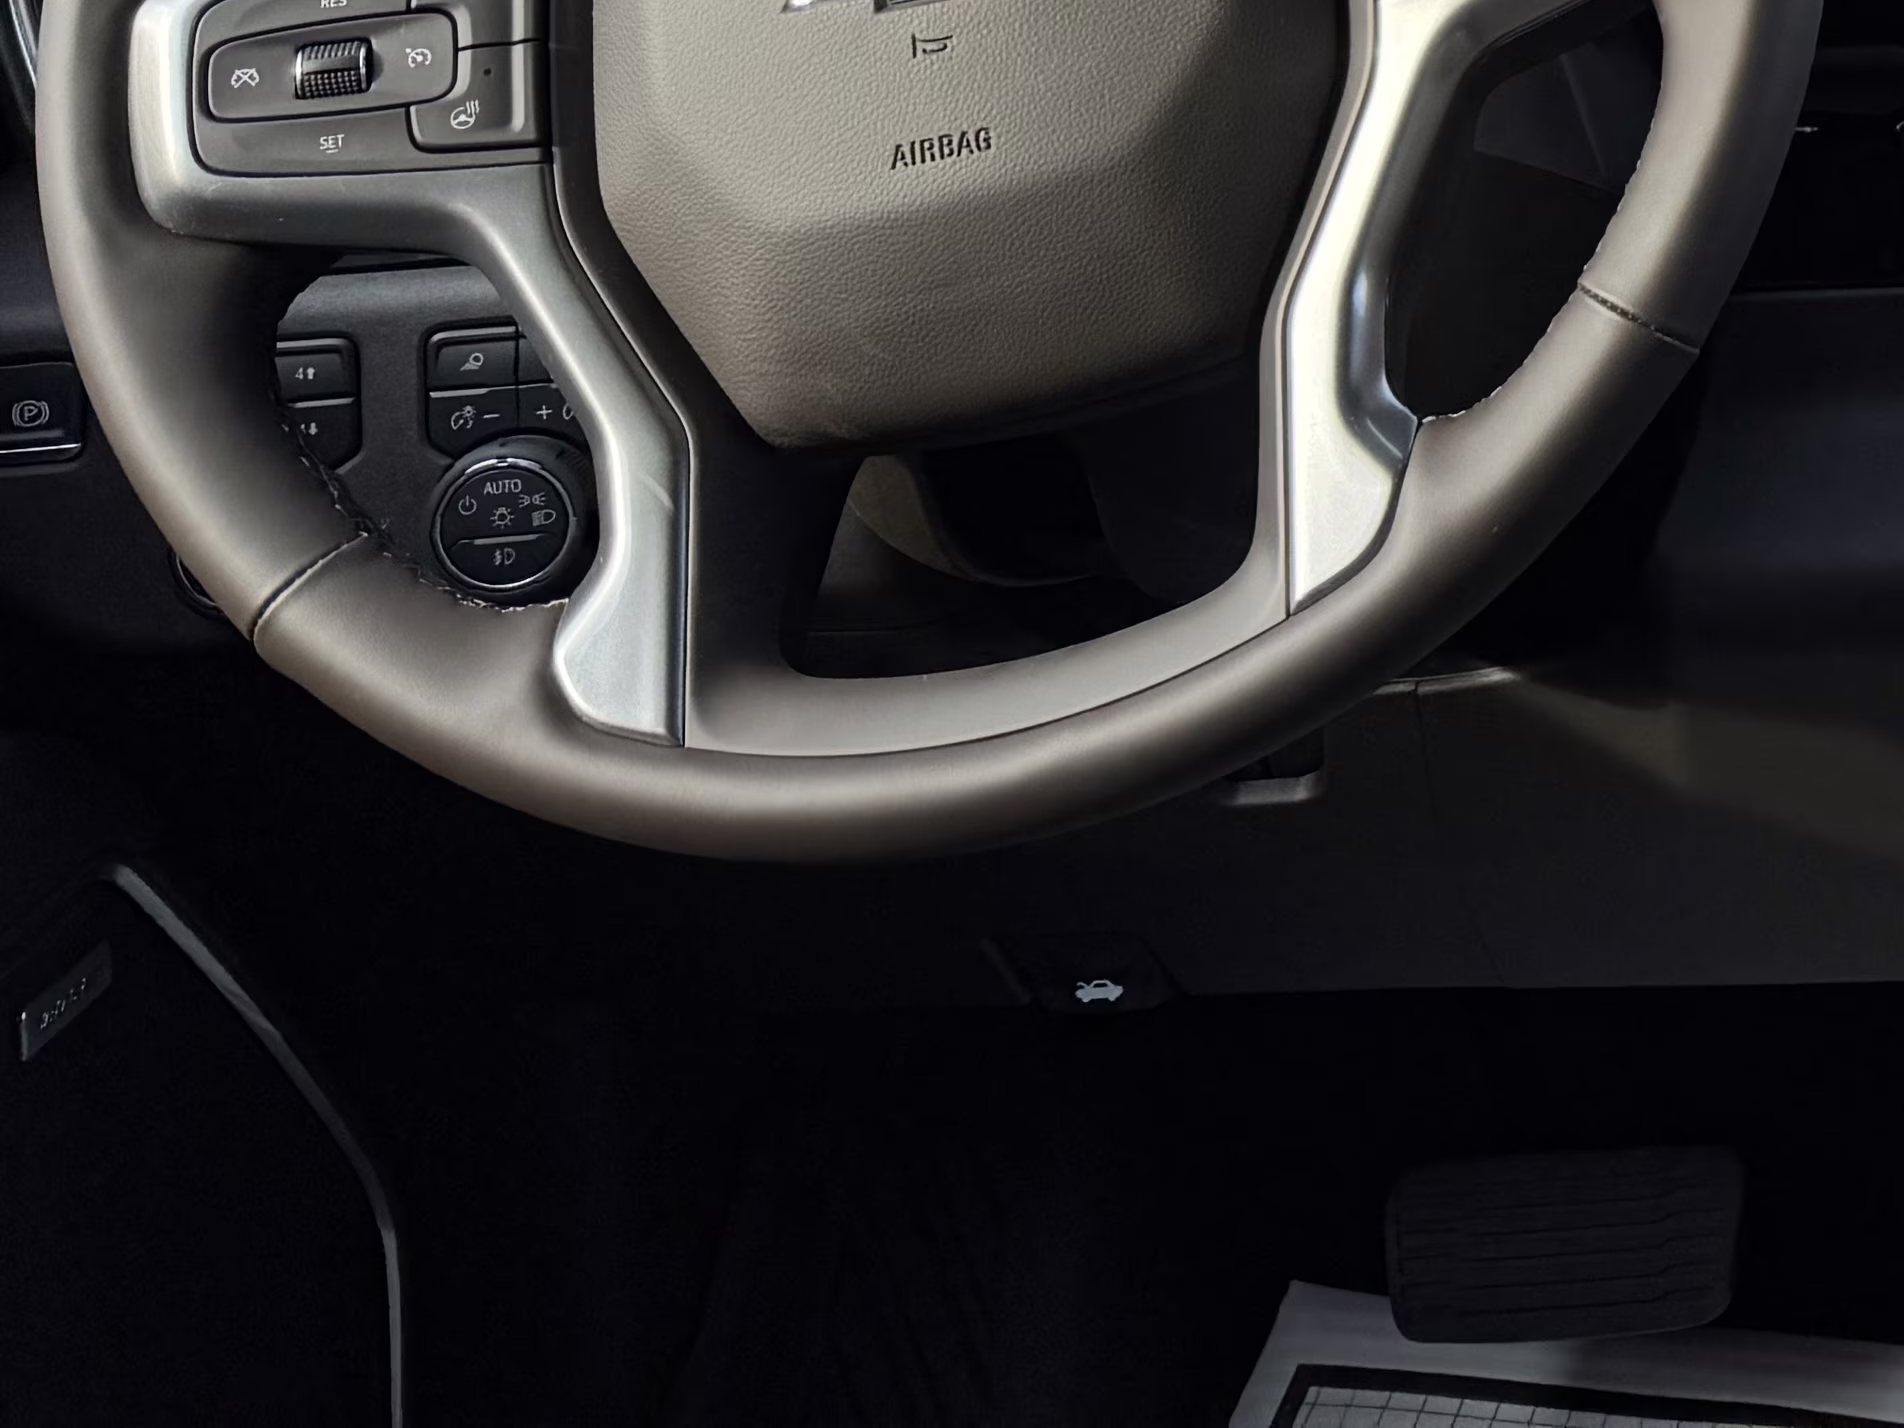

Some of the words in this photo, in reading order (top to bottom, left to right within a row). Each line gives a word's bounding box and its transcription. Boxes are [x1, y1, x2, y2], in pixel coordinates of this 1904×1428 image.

[319, 134, 345, 149] SET
[890, 127, 992, 170] AIRBAG
[483, 478, 522, 495] AUTO
